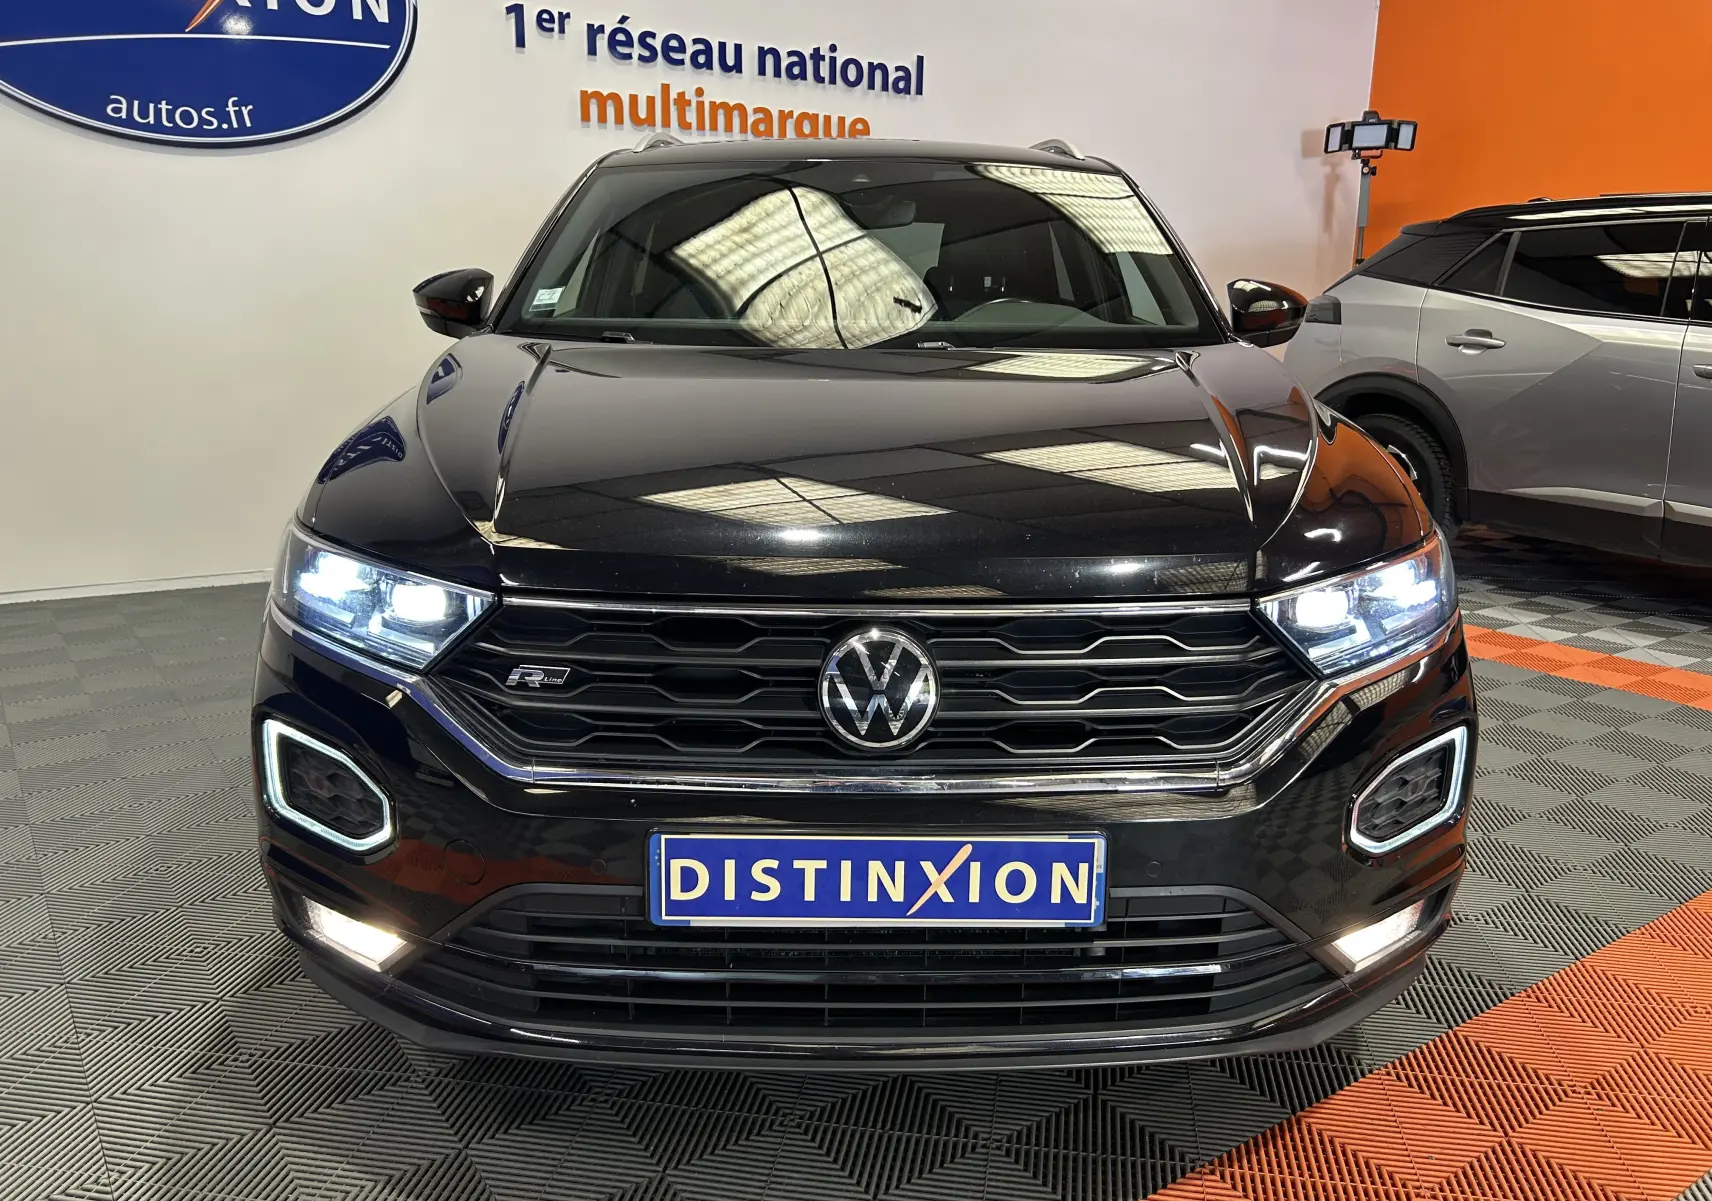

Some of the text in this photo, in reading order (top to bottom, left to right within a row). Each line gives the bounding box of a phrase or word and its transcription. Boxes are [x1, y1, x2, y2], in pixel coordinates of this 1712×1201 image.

[505, 3, 924, 96] 1er réseau national
[106, 94, 254, 130] autos.fr
[579, 83, 871, 139] multimarque
[669, 843, 1089, 916] DISTINXION
